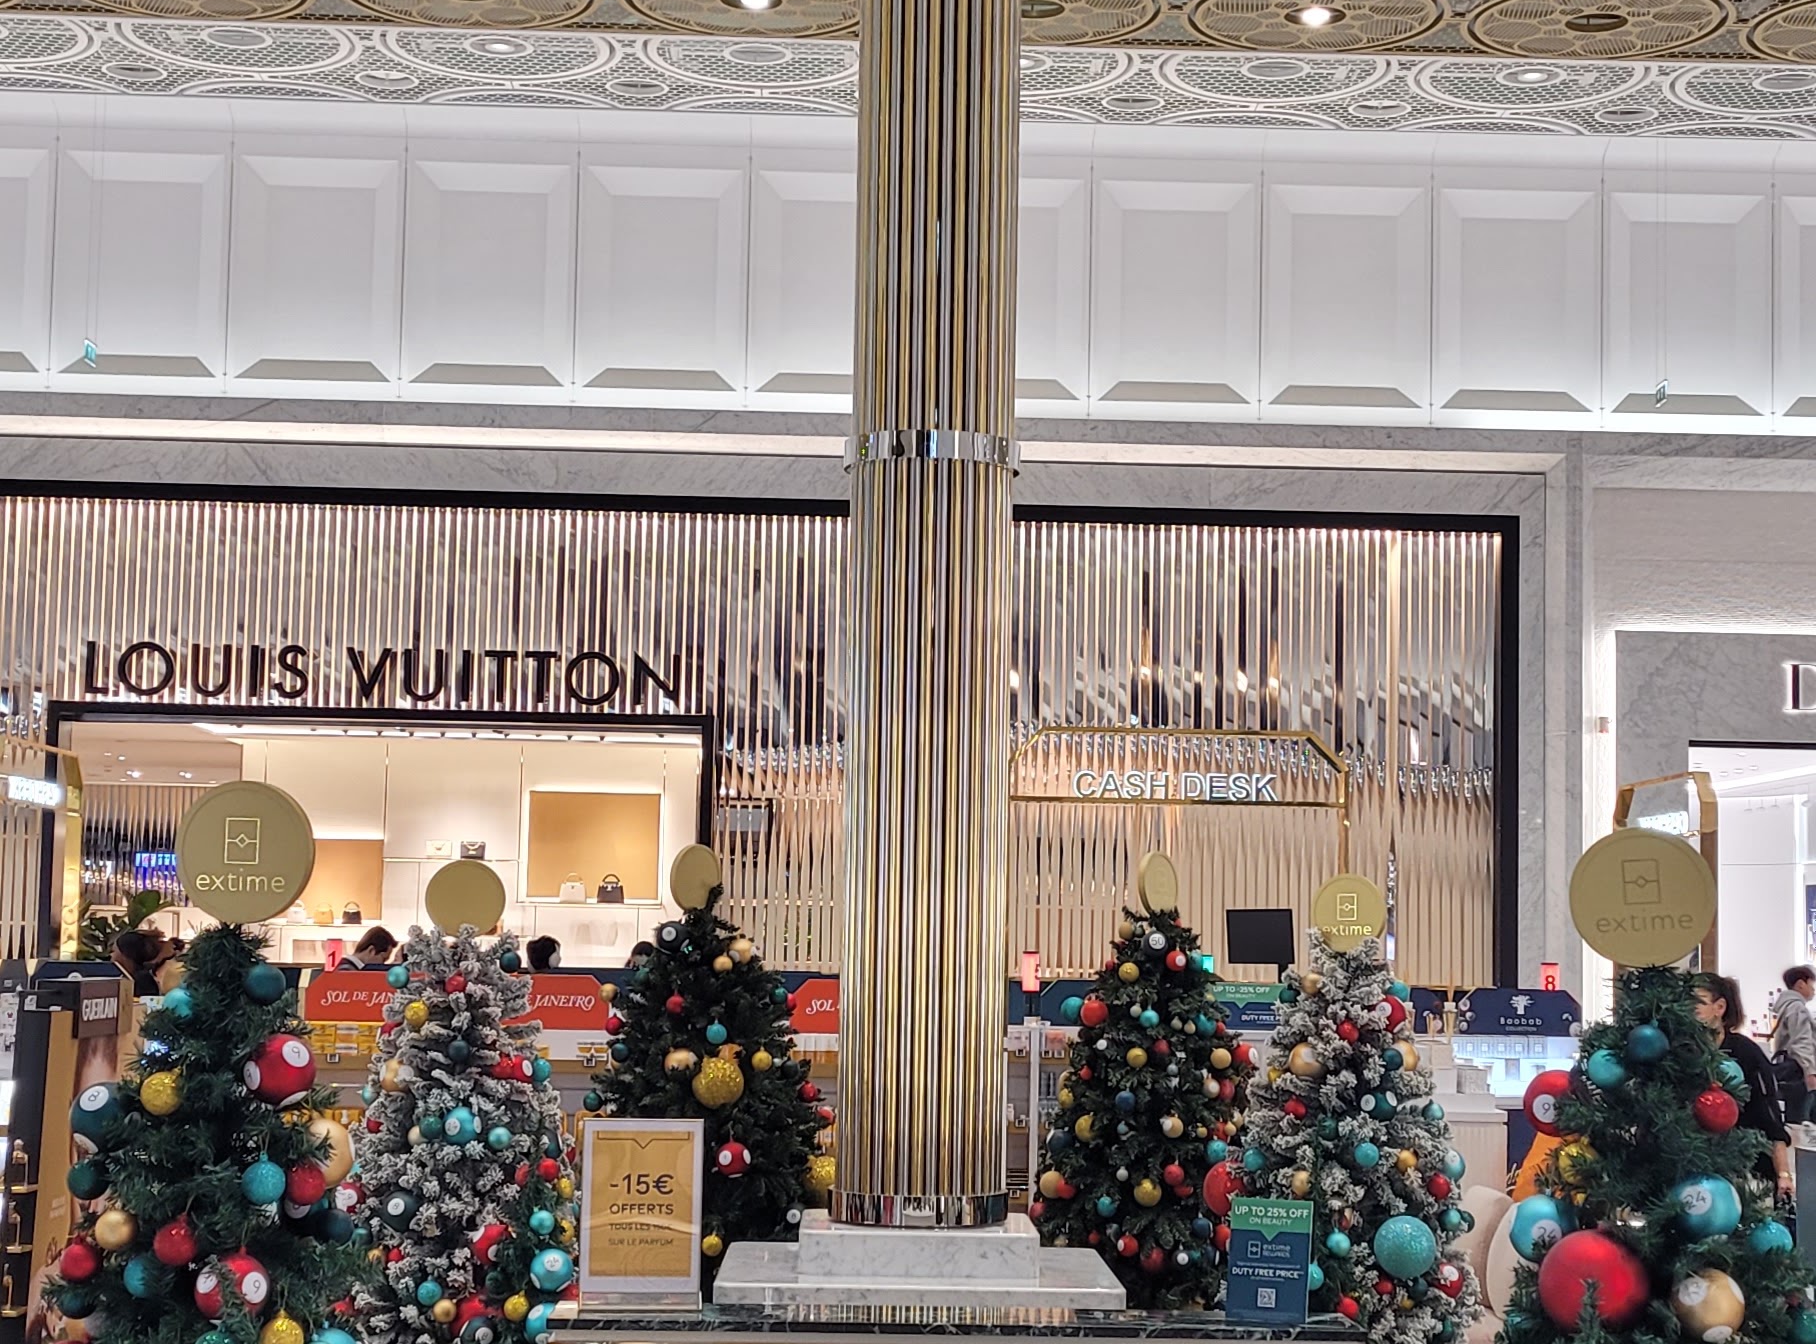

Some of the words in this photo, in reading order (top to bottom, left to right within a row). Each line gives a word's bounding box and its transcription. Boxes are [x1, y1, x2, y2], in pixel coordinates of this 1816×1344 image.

[84, 641, 309, 699] LOUIS
[346, 646, 681, 706] VUITTON
[1072, 770, 1169, 799] CASH
[1181, 772, 1278, 802] DESK
[195, 868, 286, 893] extime
[1596, 908, 1694, 934] extime
[1322, 922, 1372, 937] extime
[328, 950, 337, 968] 1
[1545, 975, 1556, 991] 8
[321, 990, 350, 1005] SOL
[352, 991, 367, 1002] DE
[82, 997, 117, 1021] GUERLAIN
[806, 999, 835, 1014] SOL
[1500, 1017, 1542, 1025] Baobab
[88, 1090, 100, 1102] 8
[1542, 1102, 1550, 1114] 9
[610, 1173, 674, 1195] -15€
[1683, 1191, 1707, 1210] 24
[609, 1203, 674, 1215] OFFERTS
[1235, 1206, 1248, 1215] UP
[1251, 1206, 1265, 1216] TO
[1266, 1207, 1287, 1218] 25%
[1289, 1208, 1309, 1218] OFF
[1232, 1267, 1253, 1275] DUTY
[1254, 1267, 1274, 1276] FREE
[252, 1280, 261, 1294] 9
